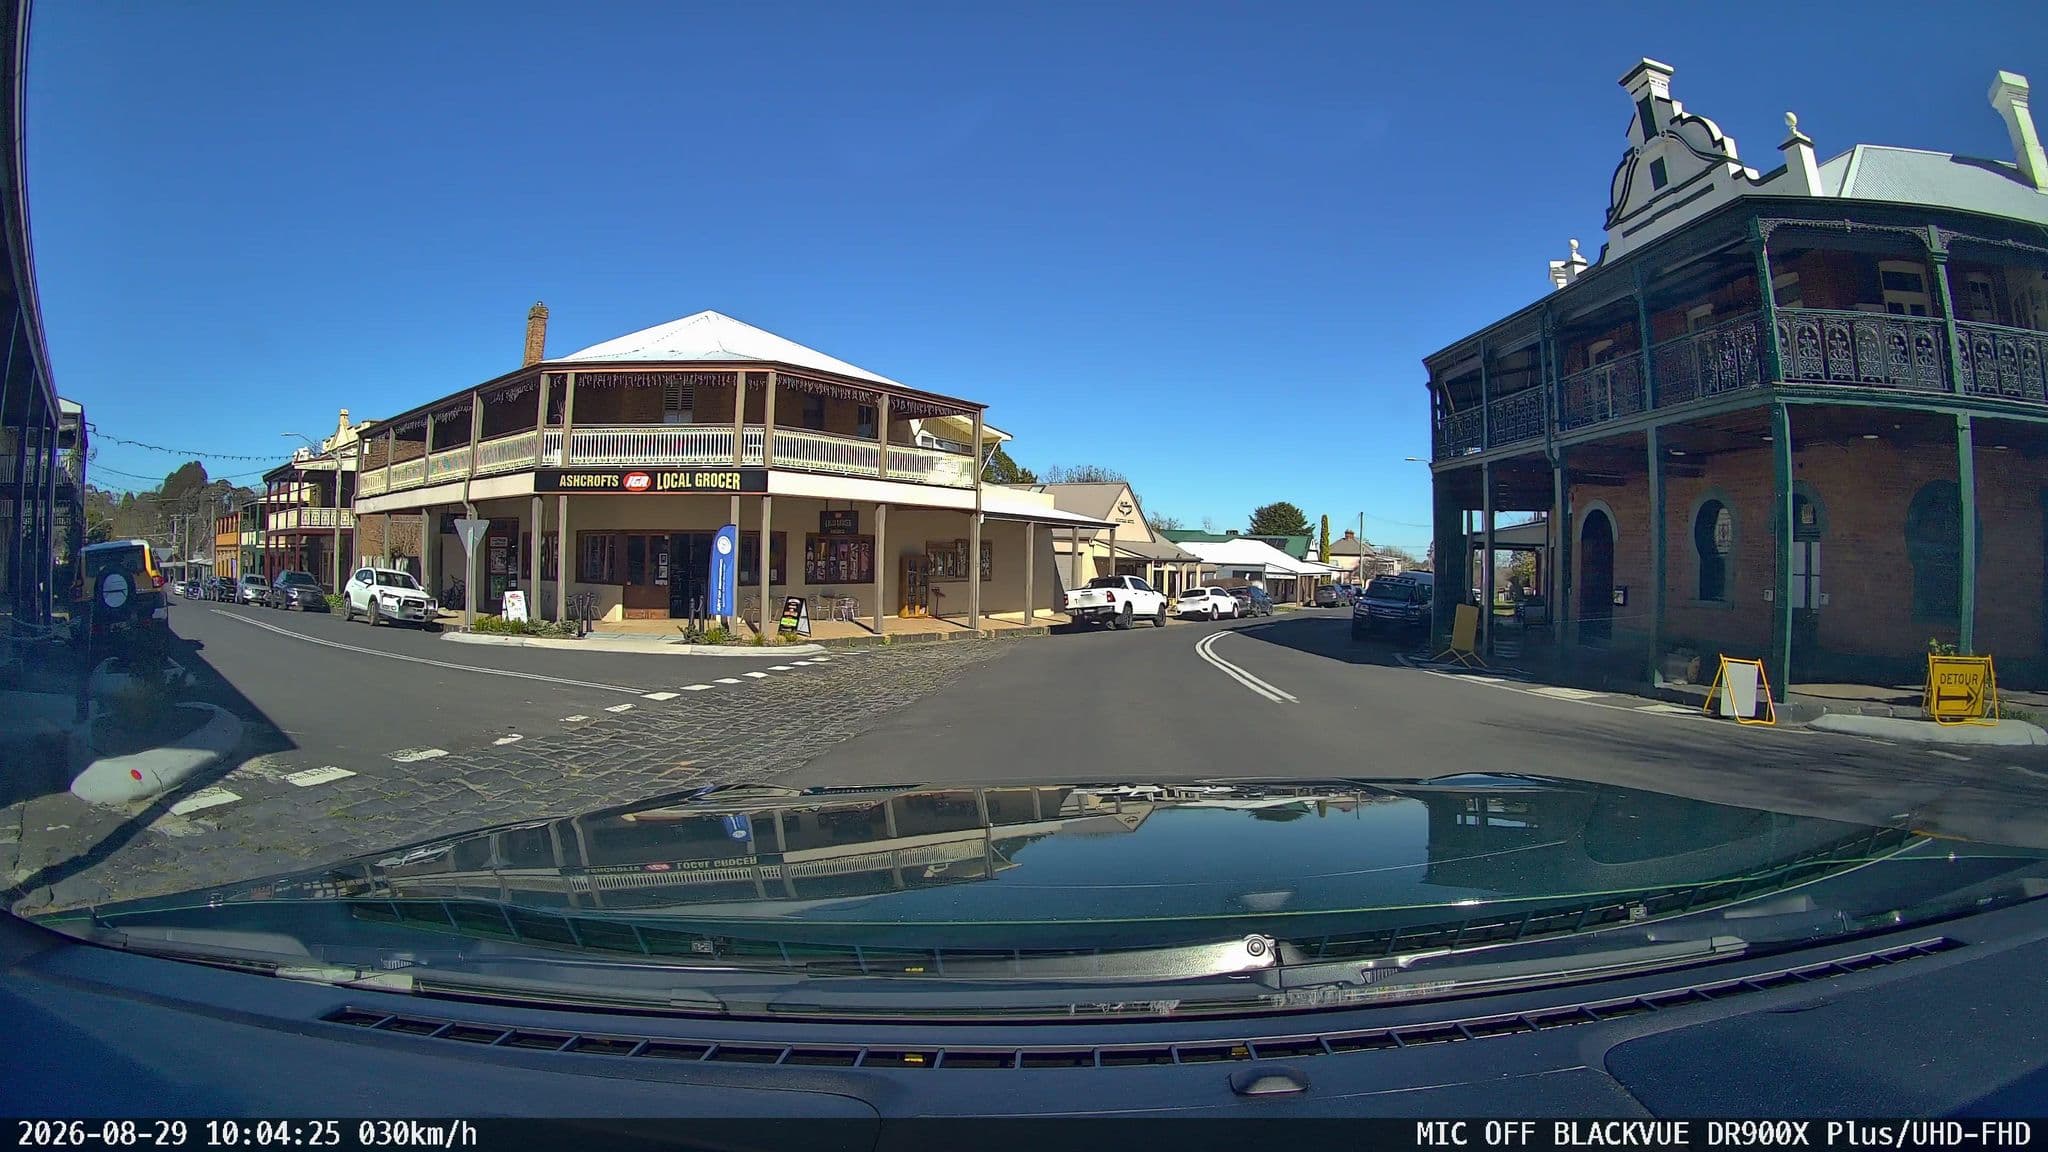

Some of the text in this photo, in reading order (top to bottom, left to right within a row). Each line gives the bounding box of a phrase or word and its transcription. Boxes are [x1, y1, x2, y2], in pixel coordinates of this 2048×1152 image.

[559, 473, 741, 490] ASHCROFTS IGA LOCAL GROCER
[1940, 673, 1979, 685] DETOUR
